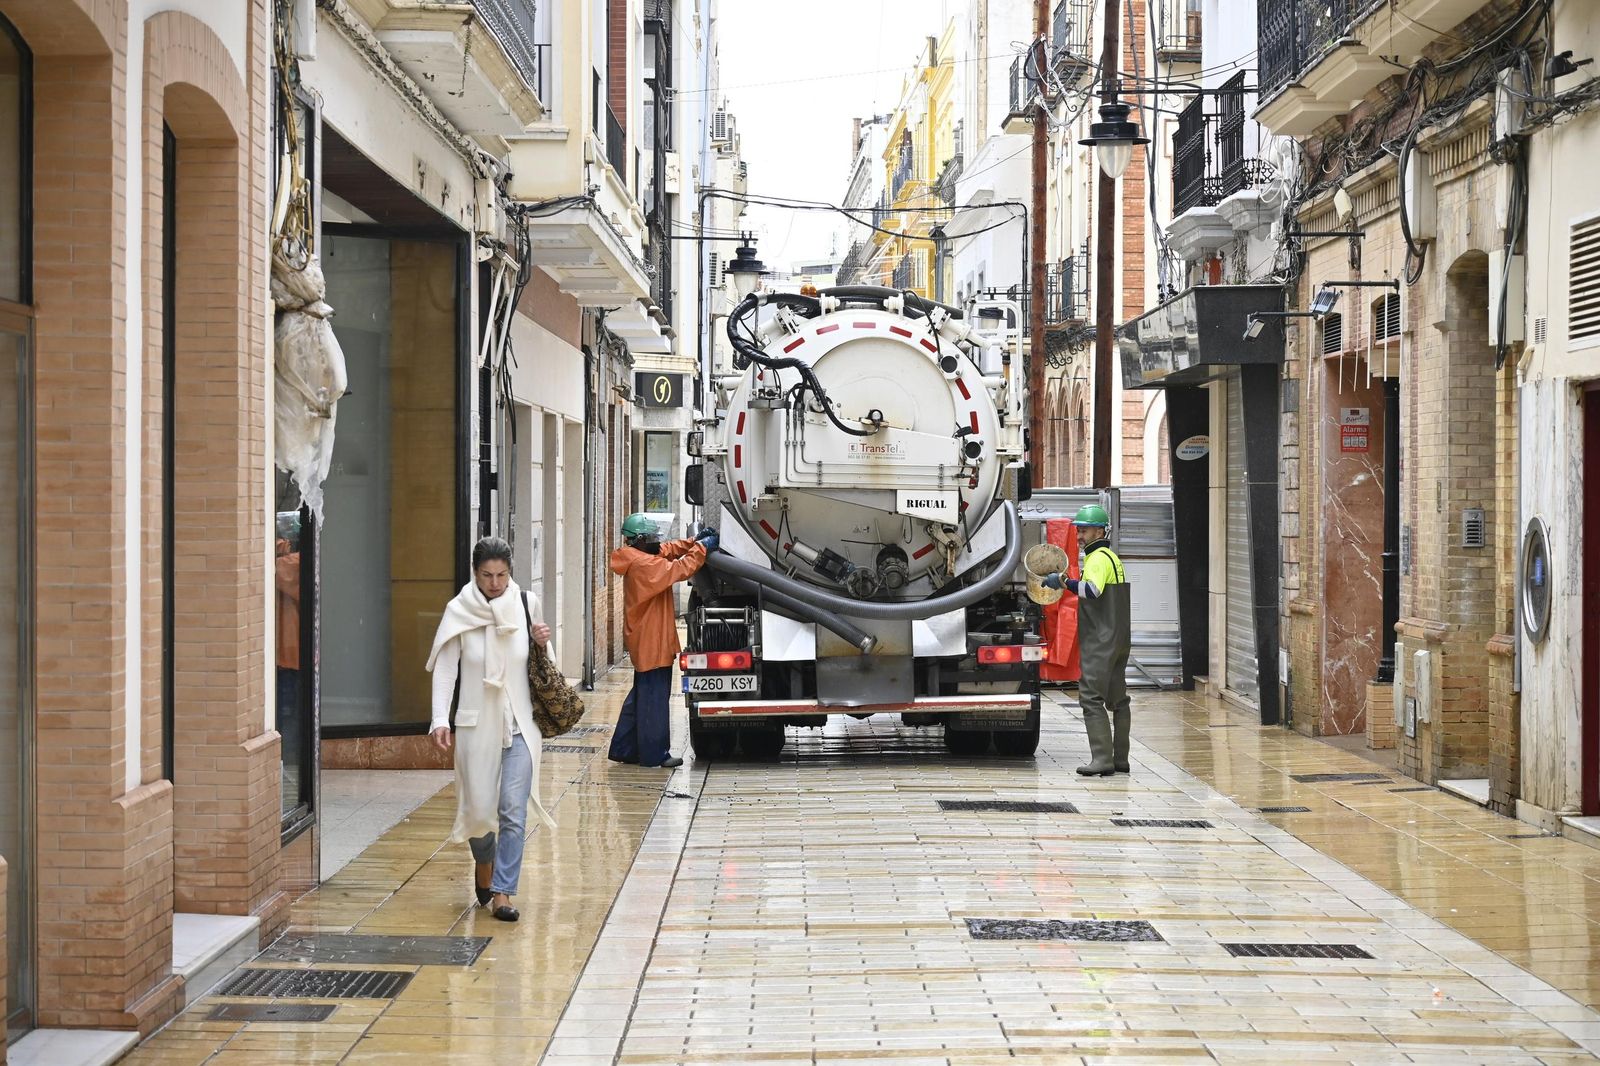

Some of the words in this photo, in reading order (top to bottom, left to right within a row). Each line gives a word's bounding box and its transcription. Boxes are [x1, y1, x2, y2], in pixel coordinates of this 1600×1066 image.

[860, 443, 899, 453] TransTel
[906, 499, 947, 509] RIGUAL
[692, 678, 723, 691] 4260
[731, 677, 753, 689] KSY
